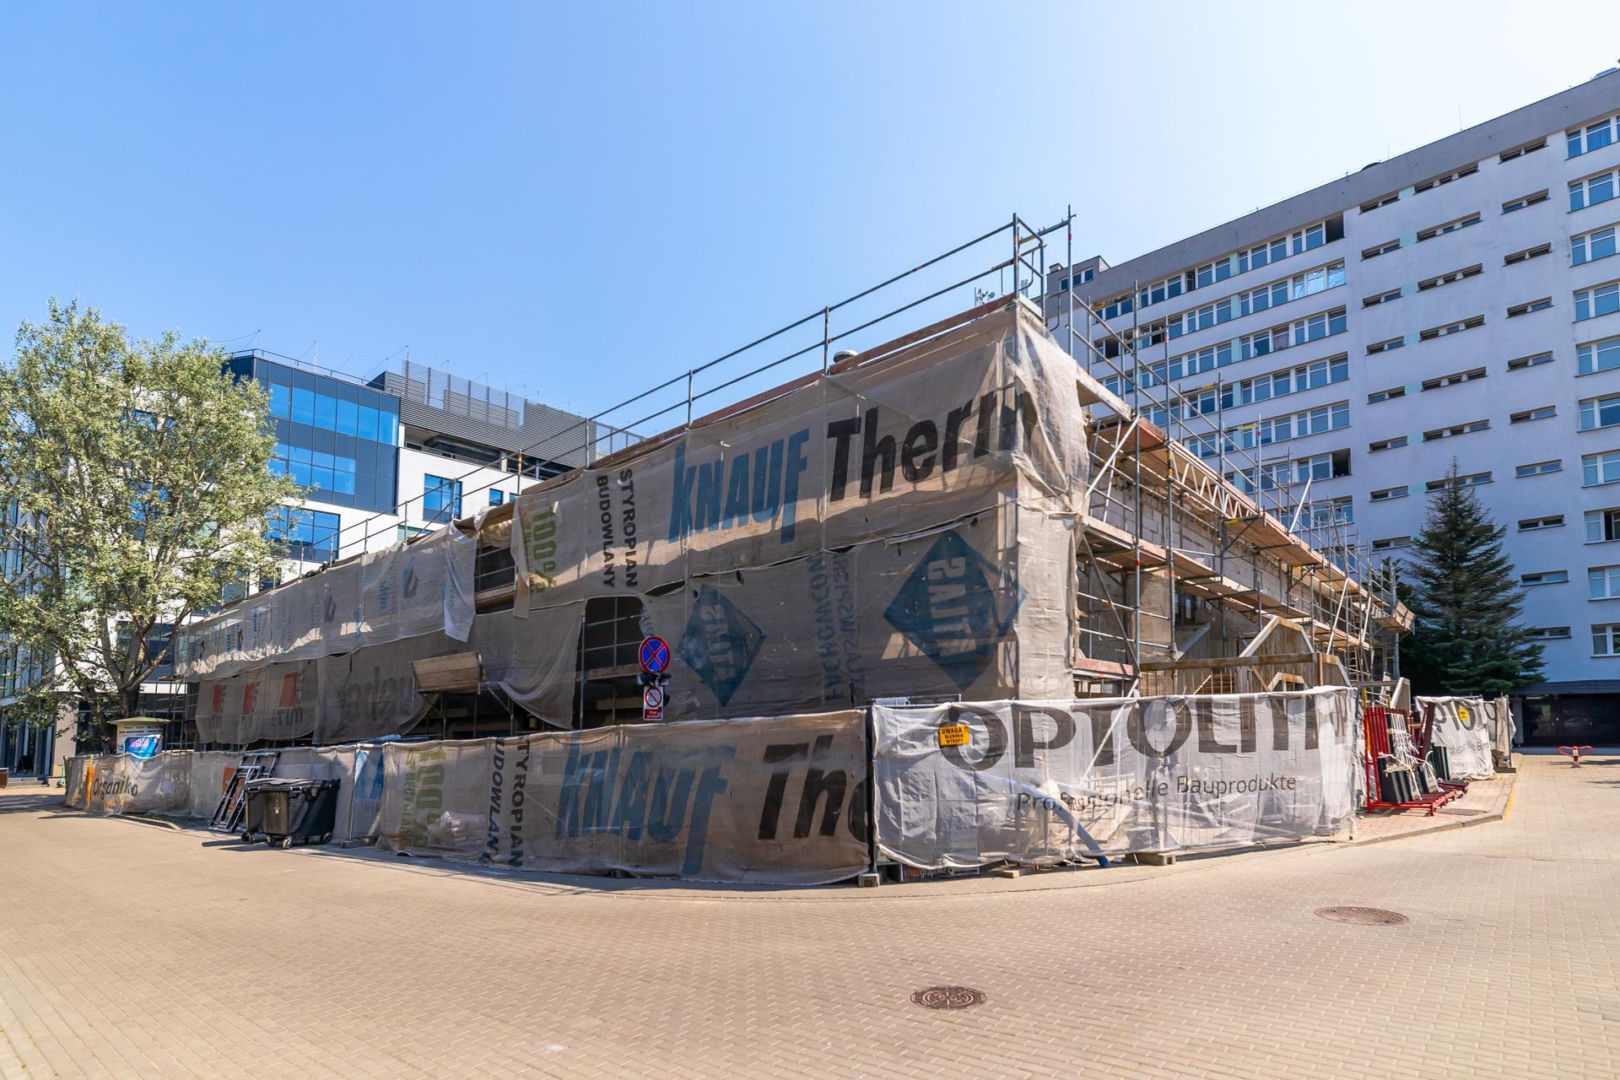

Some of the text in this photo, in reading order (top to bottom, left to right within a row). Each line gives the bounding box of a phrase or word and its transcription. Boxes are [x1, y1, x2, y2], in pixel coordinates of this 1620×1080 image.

[596, 475, 615, 588] BUDOWLANY
[620, 468, 638, 588] STYROPIAN
[667, 428, 810, 544] KNAUF
[509, 741, 530, 867] TYROPIAN
[556, 734, 736, 874] KNAUF
[1176, 772, 1296, 797] Bauprodukte
